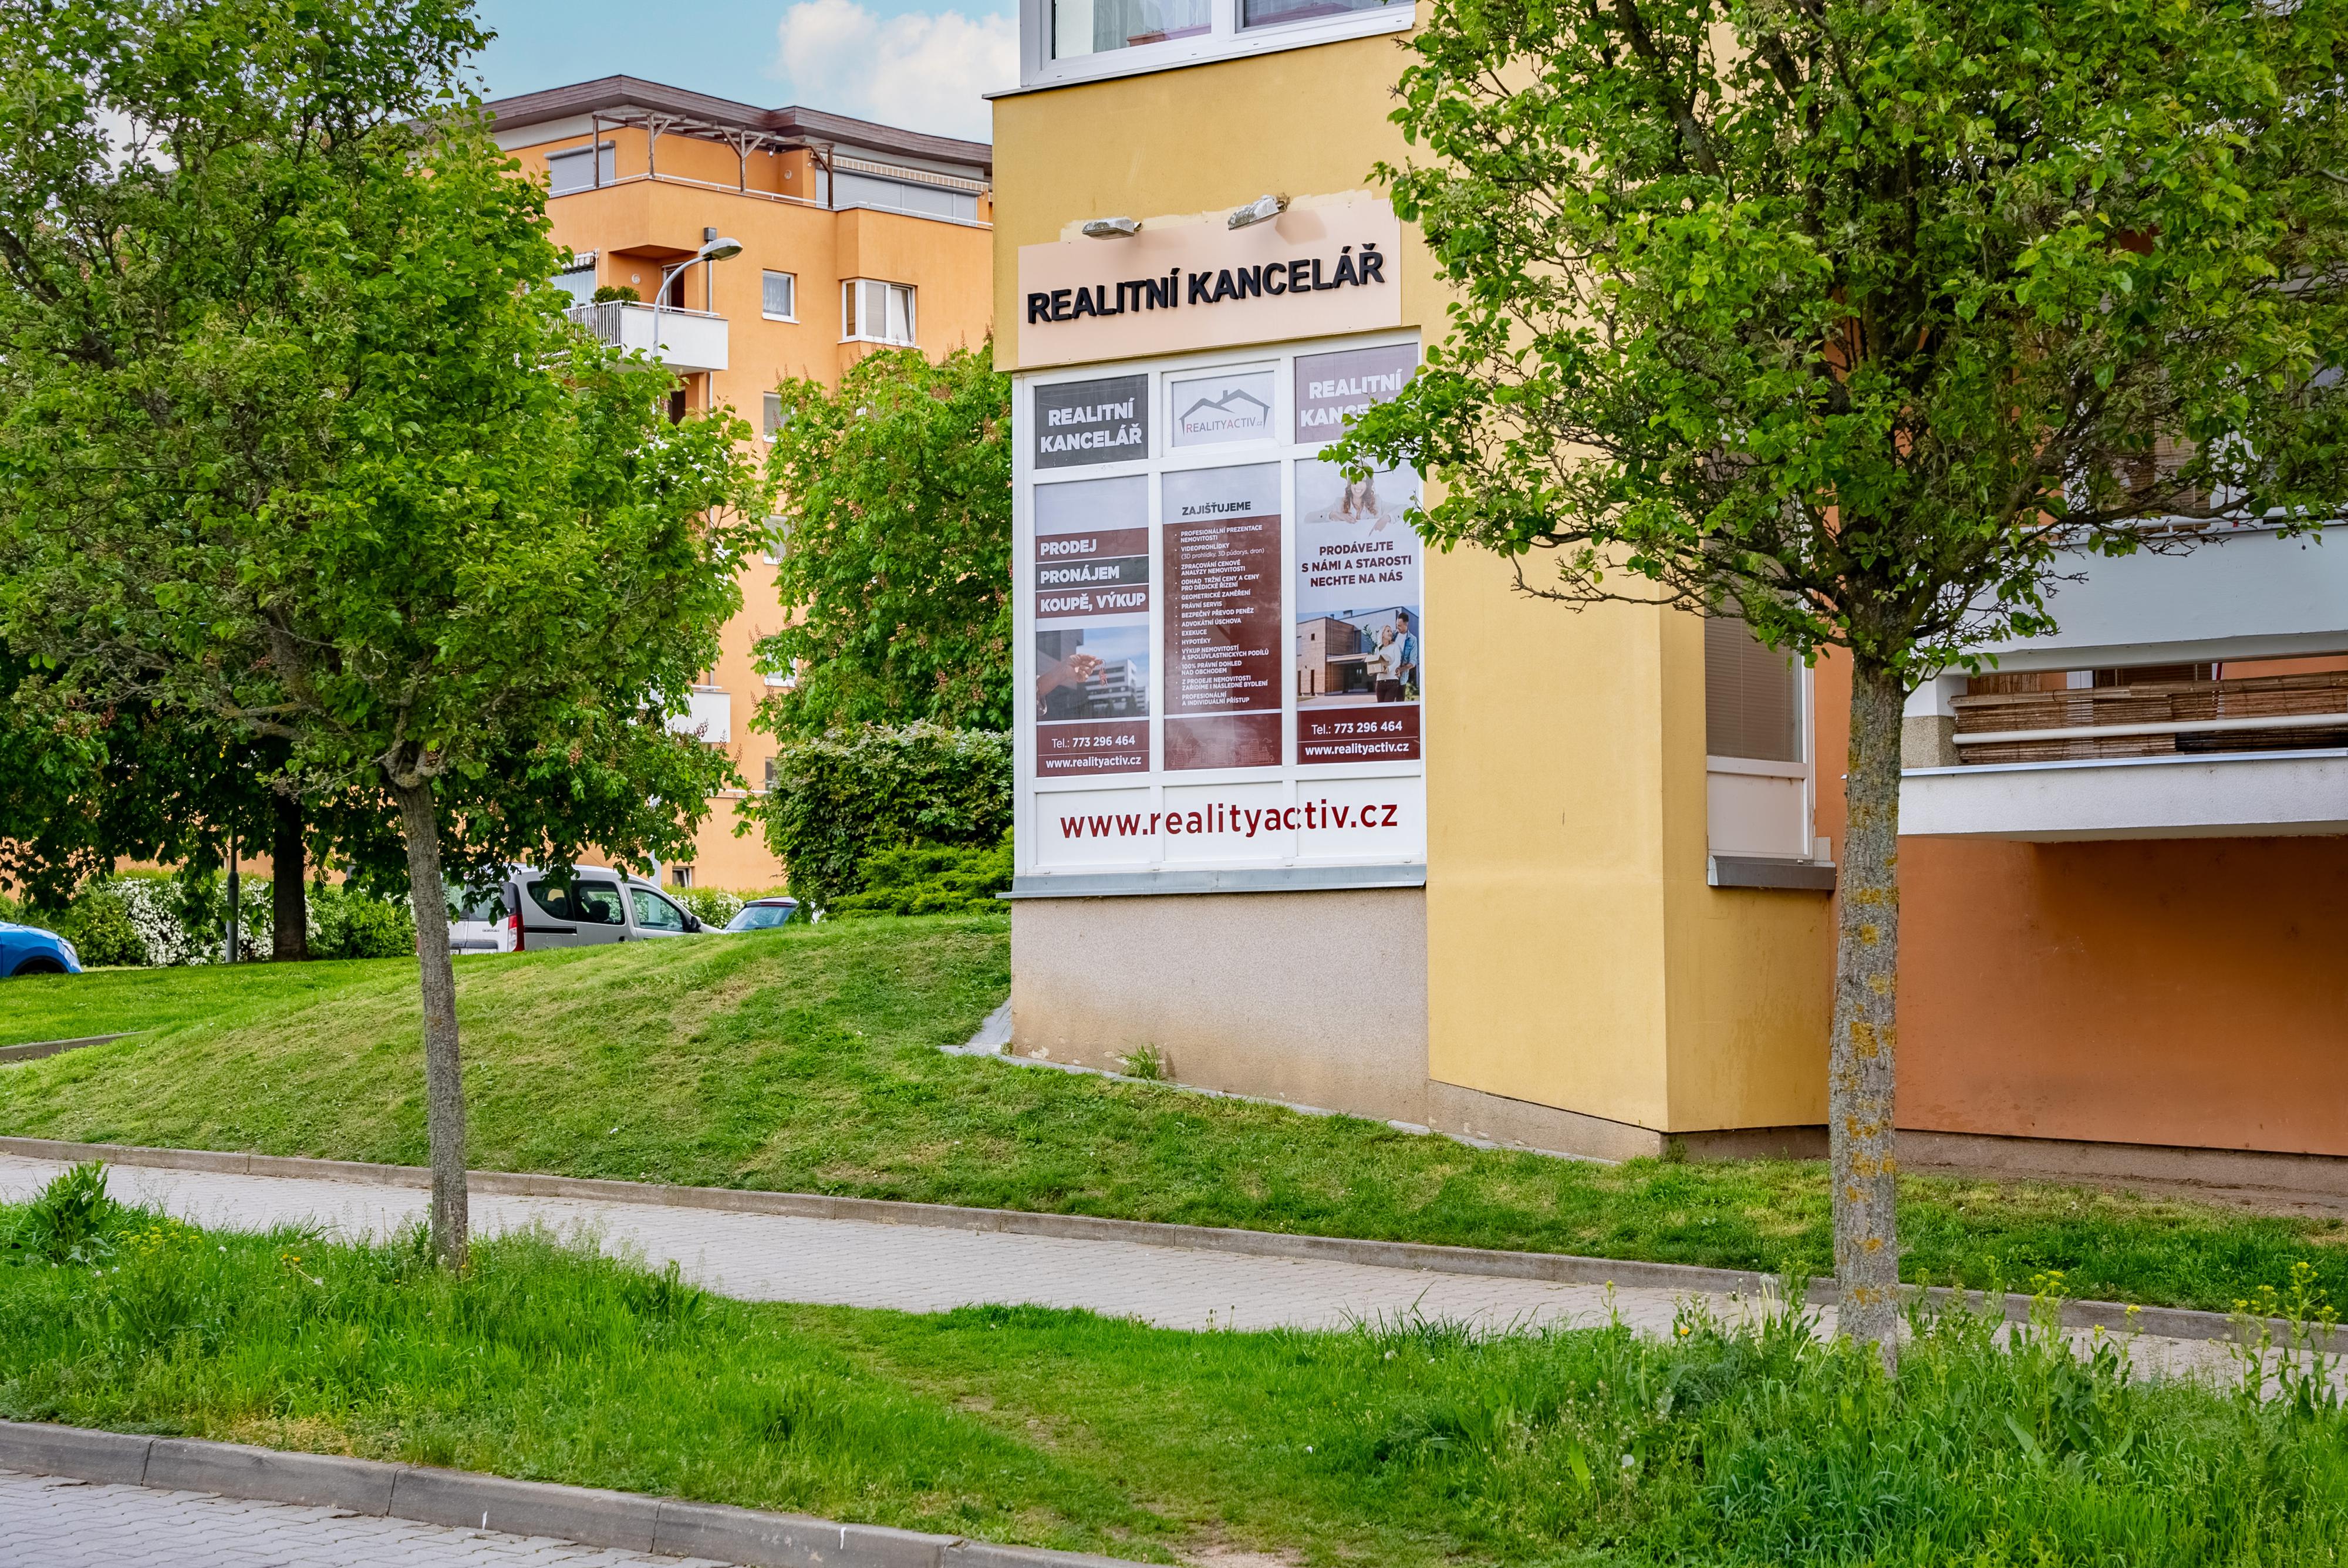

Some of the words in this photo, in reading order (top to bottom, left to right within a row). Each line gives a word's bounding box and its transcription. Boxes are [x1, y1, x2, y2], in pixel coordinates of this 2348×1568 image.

[1027, 267, 1180, 324] REALITNÍ
[1188, 242, 1385, 305] KANCELÁŘ
[1309, 369, 1403, 399] REALITNÍ
[1048, 397, 1135, 426] REALITNÍ
[1041, 423, 1142, 453] KANCELÁŘ
[1182, 501, 1251, 515] ZAJIŠŤUJEME
[1181, 527, 1226, 536] PROFESIONÁLNÍ
[1040, 539, 1097, 556] PRODEJ
[1181, 542, 1230, 552] VIDEOPROHLÍDKY
[1319, 541, 1394, 556] PRODÁVEJTE
[1181, 560, 1217, 569] ZPRACOVÁNÍ
[1301, 563, 1308, 572] S
[1312, 559, 1341, 572] NÁMI
[1344, 559, 1352, 569] A
[1356, 555, 1412, 568] STAROSTI
[1040, 565, 1119, 584] PRONÁJEM
[1310, 575, 1355, 587] NECHTE
[1359, 574, 1375, 584] NA
[1379, 569, 1403, 582] NÁS
[1040, 593, 1092, 612] KOUPĚ,
[1096, 591, 1146, 608] VÝKUP
[1182, 589, 1221, 600] GEOMETRICKÉ
[1182, 610, 1211, 618] BEZPEČNÝ
[1182, 618, 1214, 627] ADVOKÁTNÍ
[1187, 650, 1247, 660] SPOLUVLASTNICKÝCH
[1213, 680, 1243, 689] NÁSLEDNÉ
[1182, 691, 1227, 700] PROFESIONÁLNÍ
[1188, 697, 1226, 706] INDIVIDUÁLNÍ
[1311, 724, 1331, 734] Tel.:
[1334, 723, 1354, 734] 773
[1357, 722, 1377, 733] 296
[1381, 720, 1402, 731] 464
[1052, 739, 1070, 748] Tel.:
[1072, 737, 1091, 747] 773
[1094, 736, 1112, 746] 296
[1115, 736, 1135, 745] 464
[1305, 741, 1409, 756] www.realityactiv.cz
[1046, 756, 1141, 768] www.realityactiv.cz
[1060, 798, 1399, 839] www.realityactiv.cz
